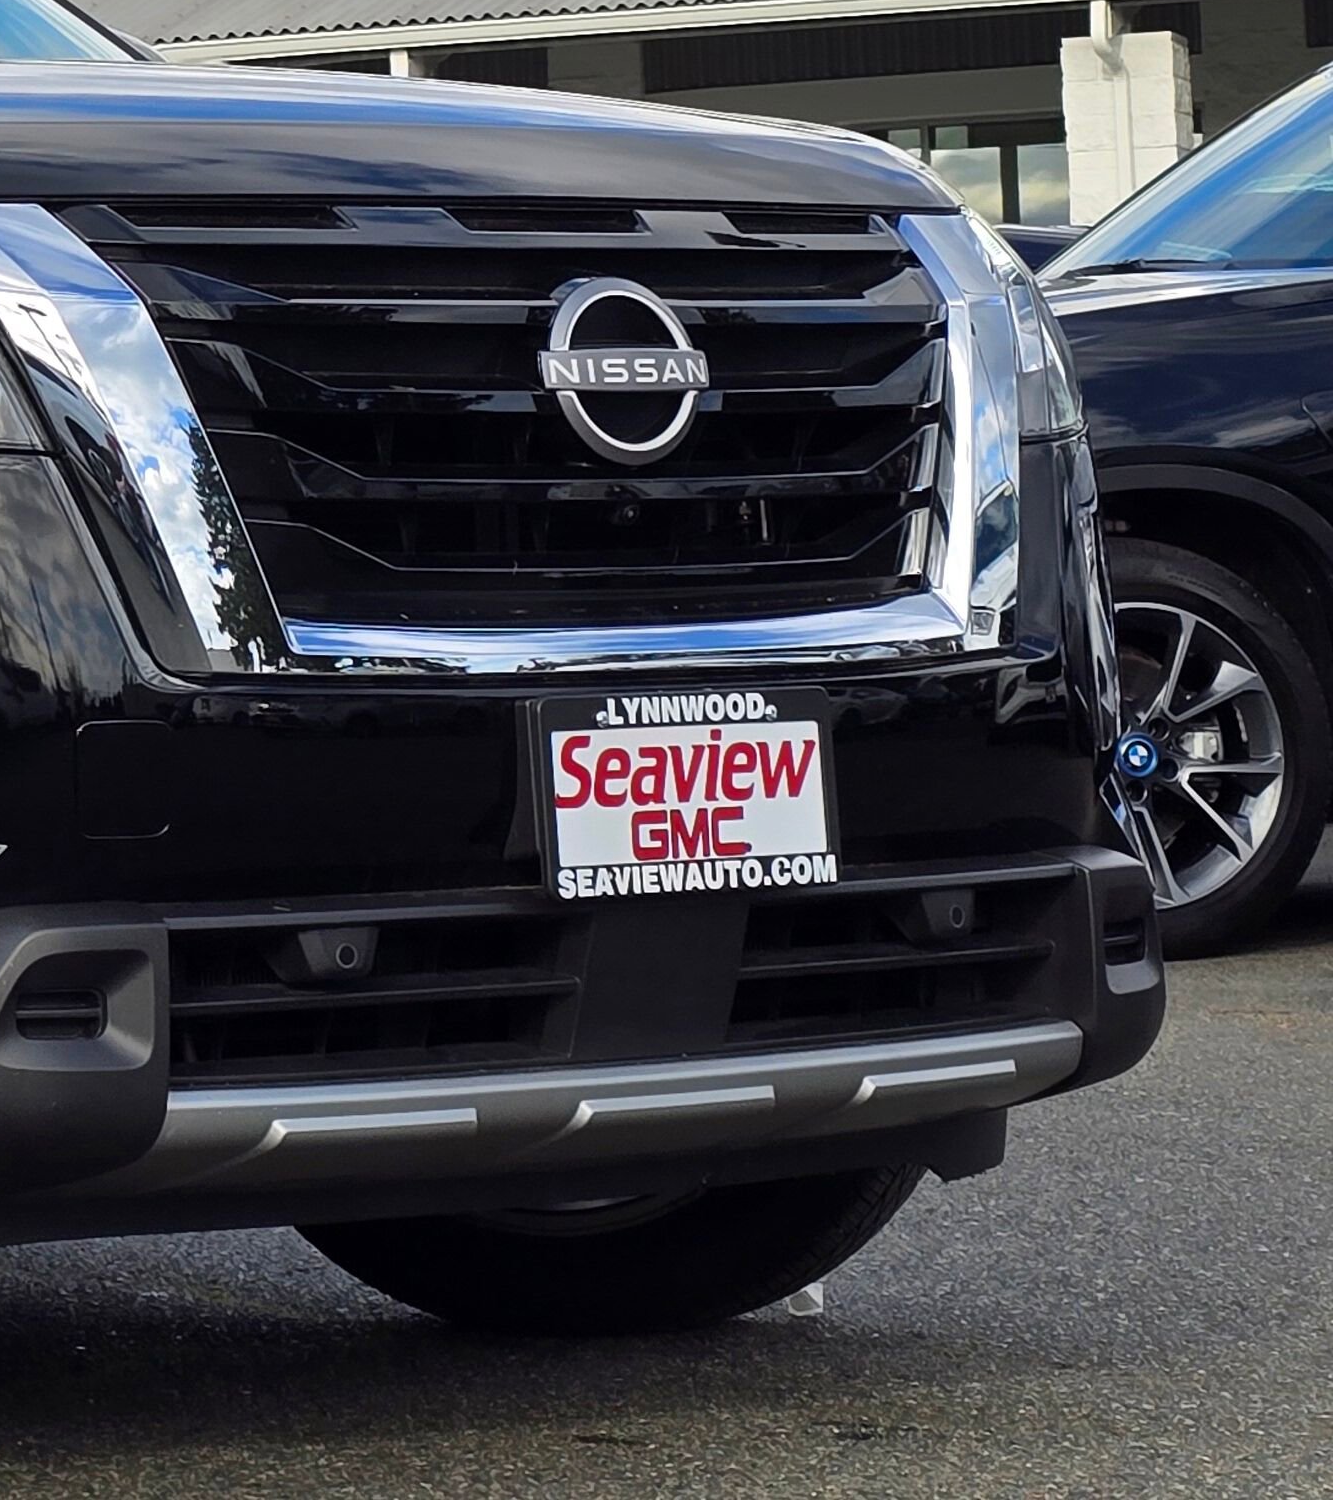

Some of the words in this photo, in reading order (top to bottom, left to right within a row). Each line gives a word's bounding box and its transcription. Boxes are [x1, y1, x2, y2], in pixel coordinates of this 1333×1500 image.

[547, 358, 707, 384] NISSAN
[606, 692, 766, 726] LYNNWOOD
[555, 728, 817, 809] Seaview
[630, 806, 752, 861] GMC
[557, 855, 838, 900] SEAVIEWAUTO.COM
